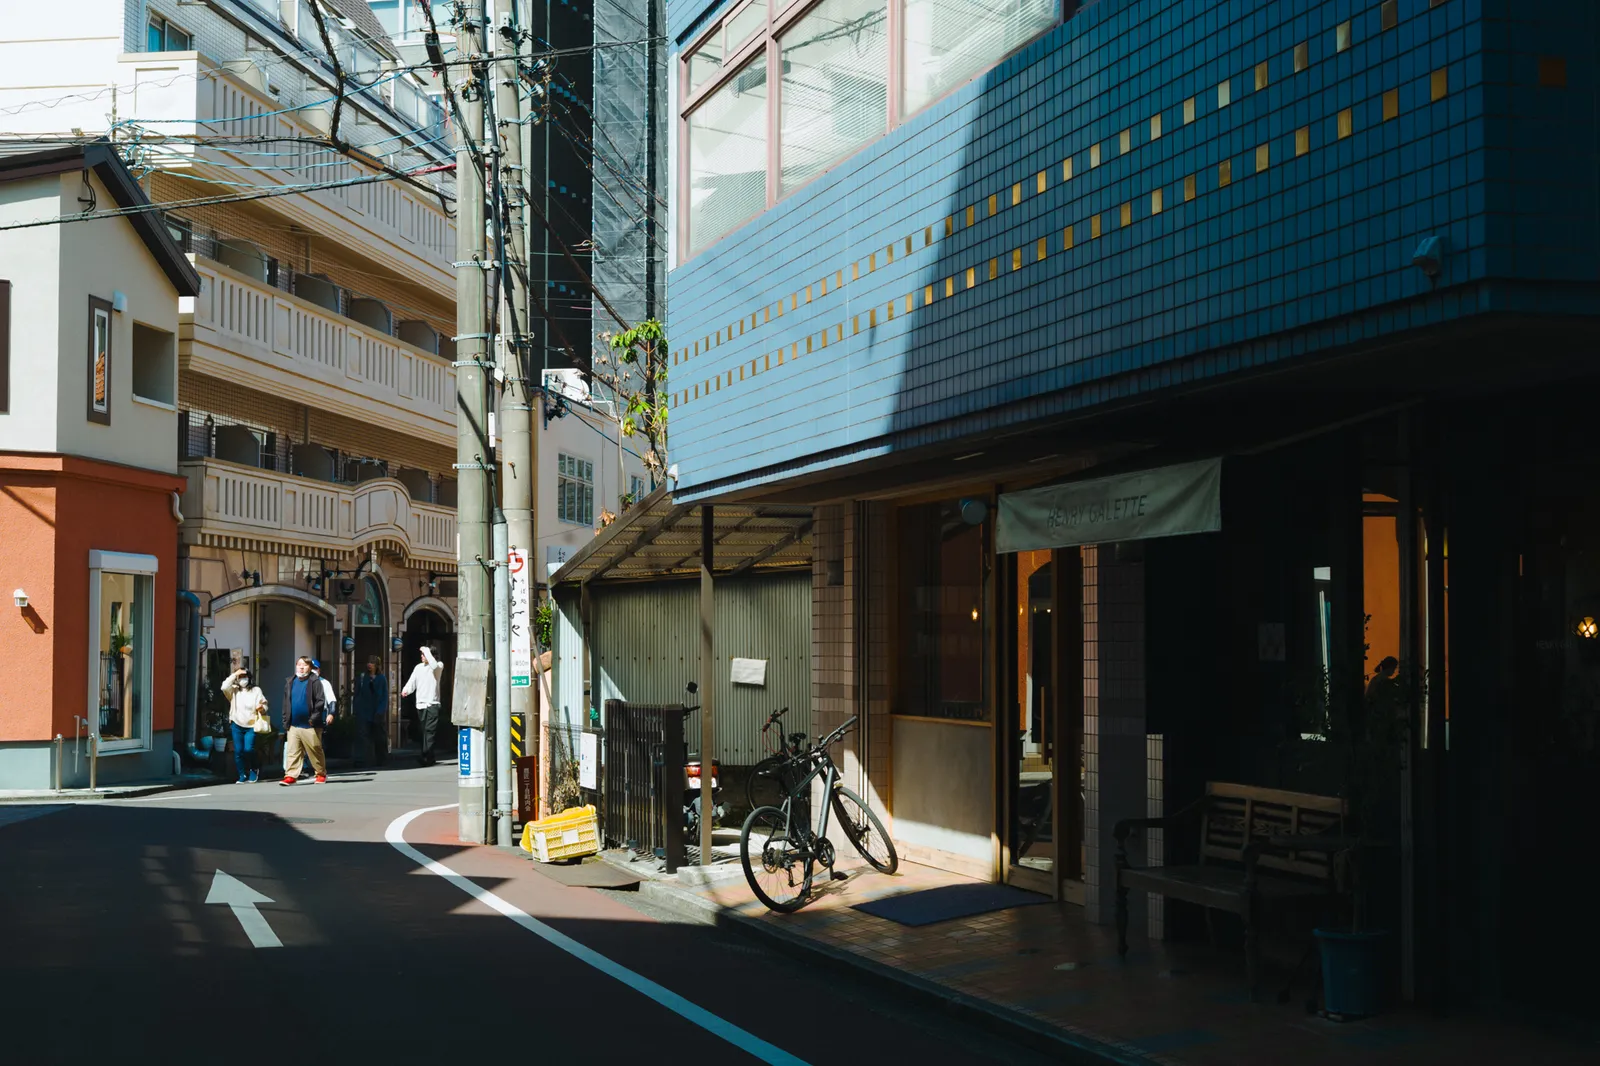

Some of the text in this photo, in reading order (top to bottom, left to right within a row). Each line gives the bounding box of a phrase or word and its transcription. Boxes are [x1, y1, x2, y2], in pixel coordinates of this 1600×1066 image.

[1046, 494, 1148, 529] HENRY GALETTE
[461, 752, 470, 761] 12
